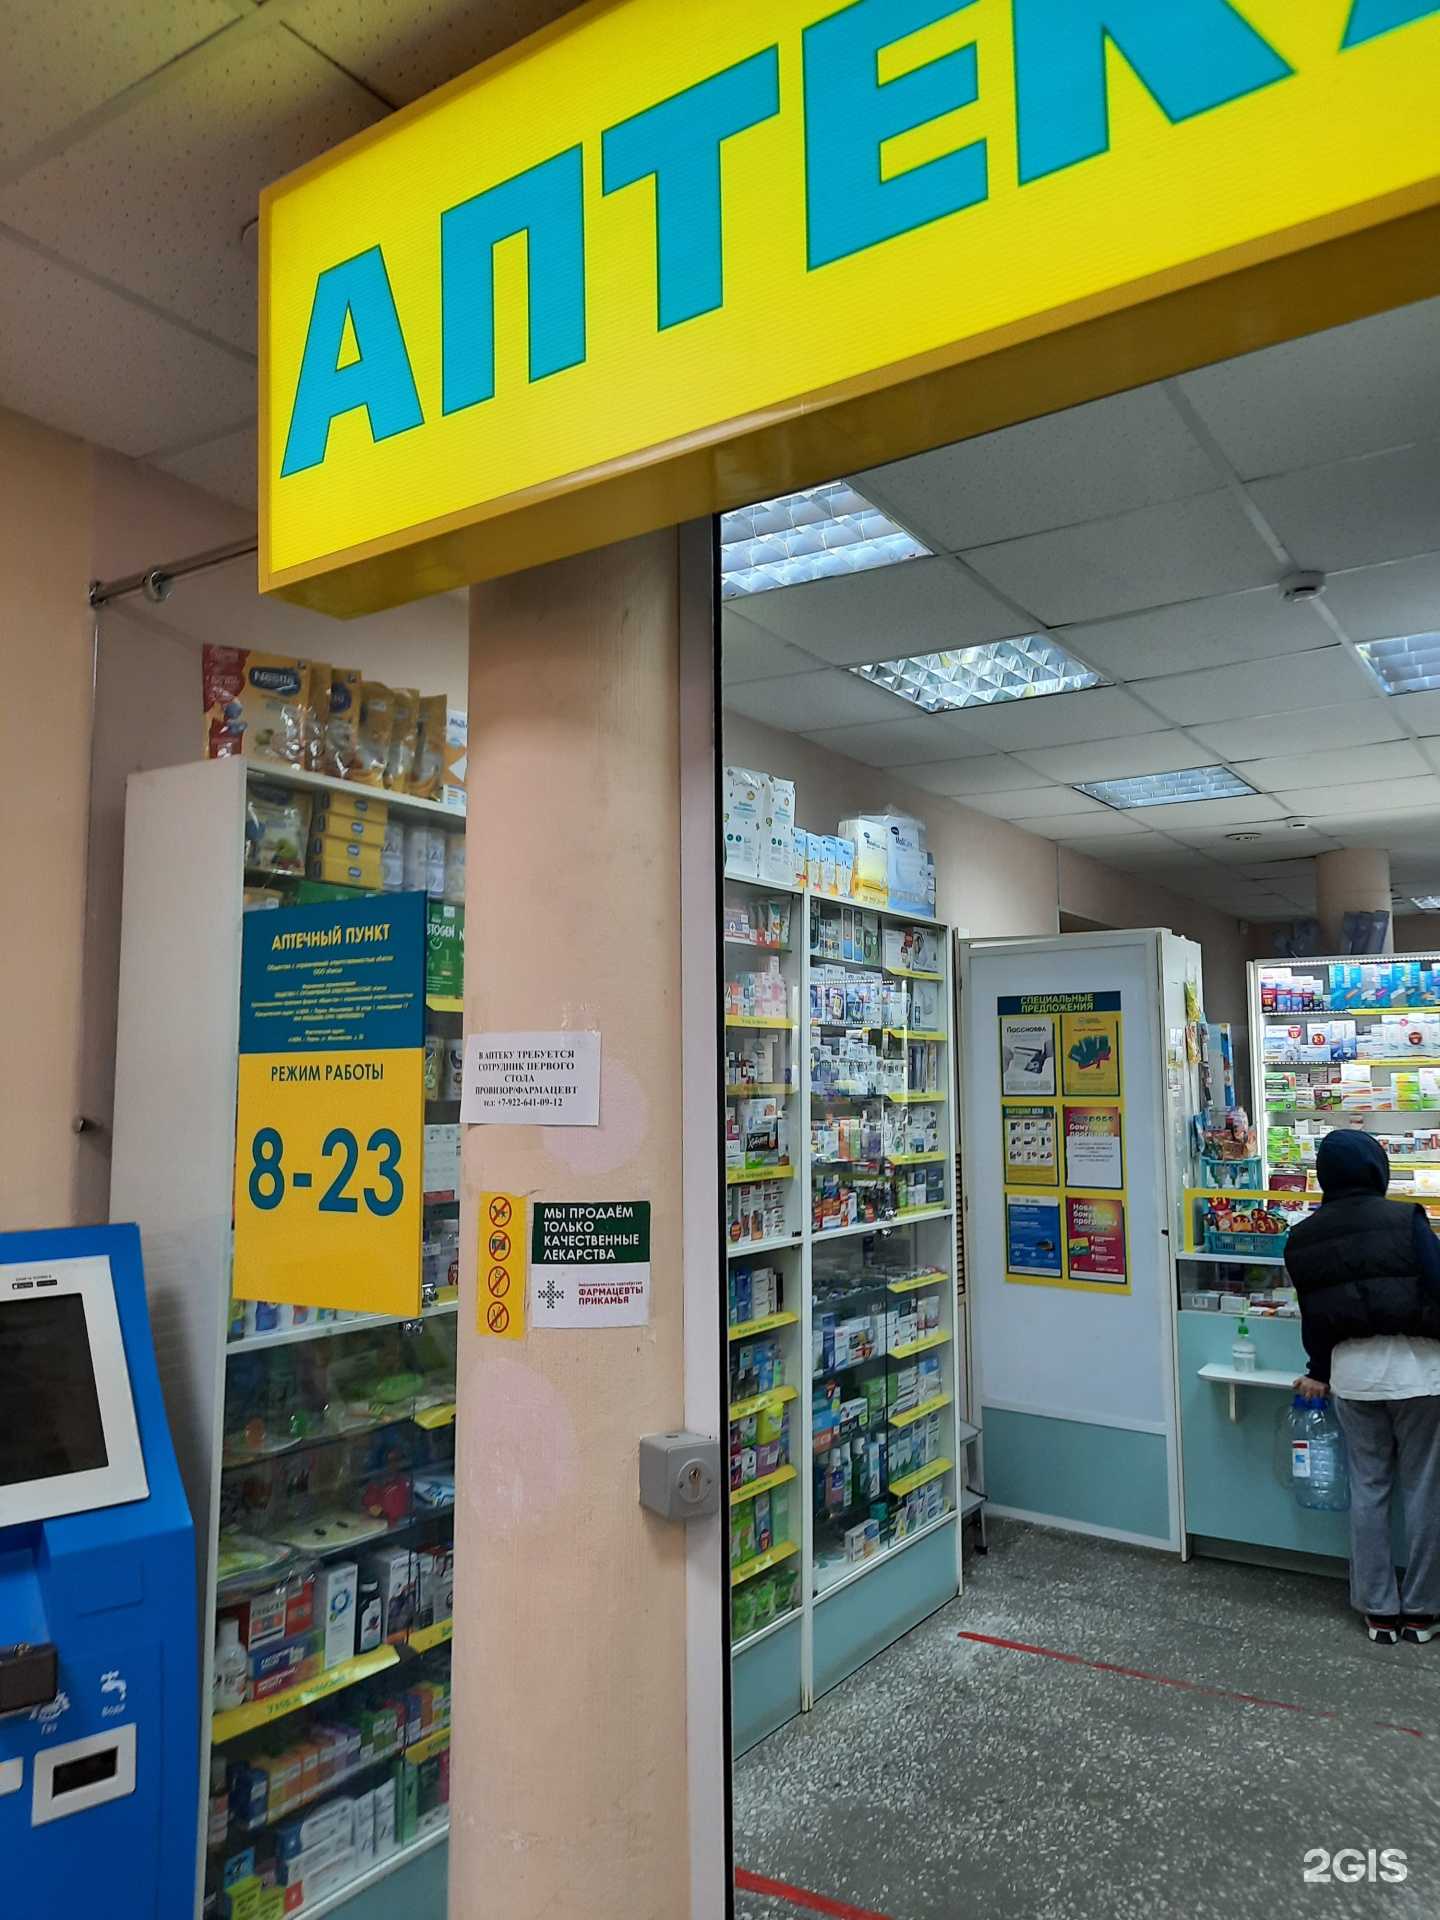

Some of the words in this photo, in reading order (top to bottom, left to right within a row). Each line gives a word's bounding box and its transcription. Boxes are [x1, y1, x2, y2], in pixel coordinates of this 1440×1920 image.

[280, 0, 1440, 478] АПТЕК
[271, 925, 342, 951] АПТЕЧНЫЙ
[345, 923, 391, 945] ПУНКТ
[1020, 993, 1094, 1005] СПЕЦИАЛЬНЫЕ
[1021, 1002, 1094, 1014] ПРЕДЛОЖЕНИЯ
[484, 1050, 514, 1060] АПТЕКУ
[517, 1049, 575, 1059] ТРЕБУЕТСЯ
[271, 1065, 321, 1082] РЕЖИМ
[325, 1063, 384, 1081] РАБОТЫ
[478, 1063, 525, 1072] СОТРУДНИК
[527, 1062, 575, 1071] ПЕРВОГО
[504, 1074, 535, 1083] СТОЛА
[248, 1126, 405, 1217] 8-23
[544, 1207, 566, 1219] МЫ
[569, 1204, 634, 1219] ПРОДАЁМ
[543, 1221, 595, 1233] ТОЛЬКО
[544, 1234, 640, 1247] КАЧЕСТВЕННЫЕ
[543, 1249, 616, 1261] ЛЕКАРСТВА
[578, 1286, 644, 1297] ФАРМАЦЕВТЫ
[578, 1296, 630, 1306] ПРИКАМЬЯ
